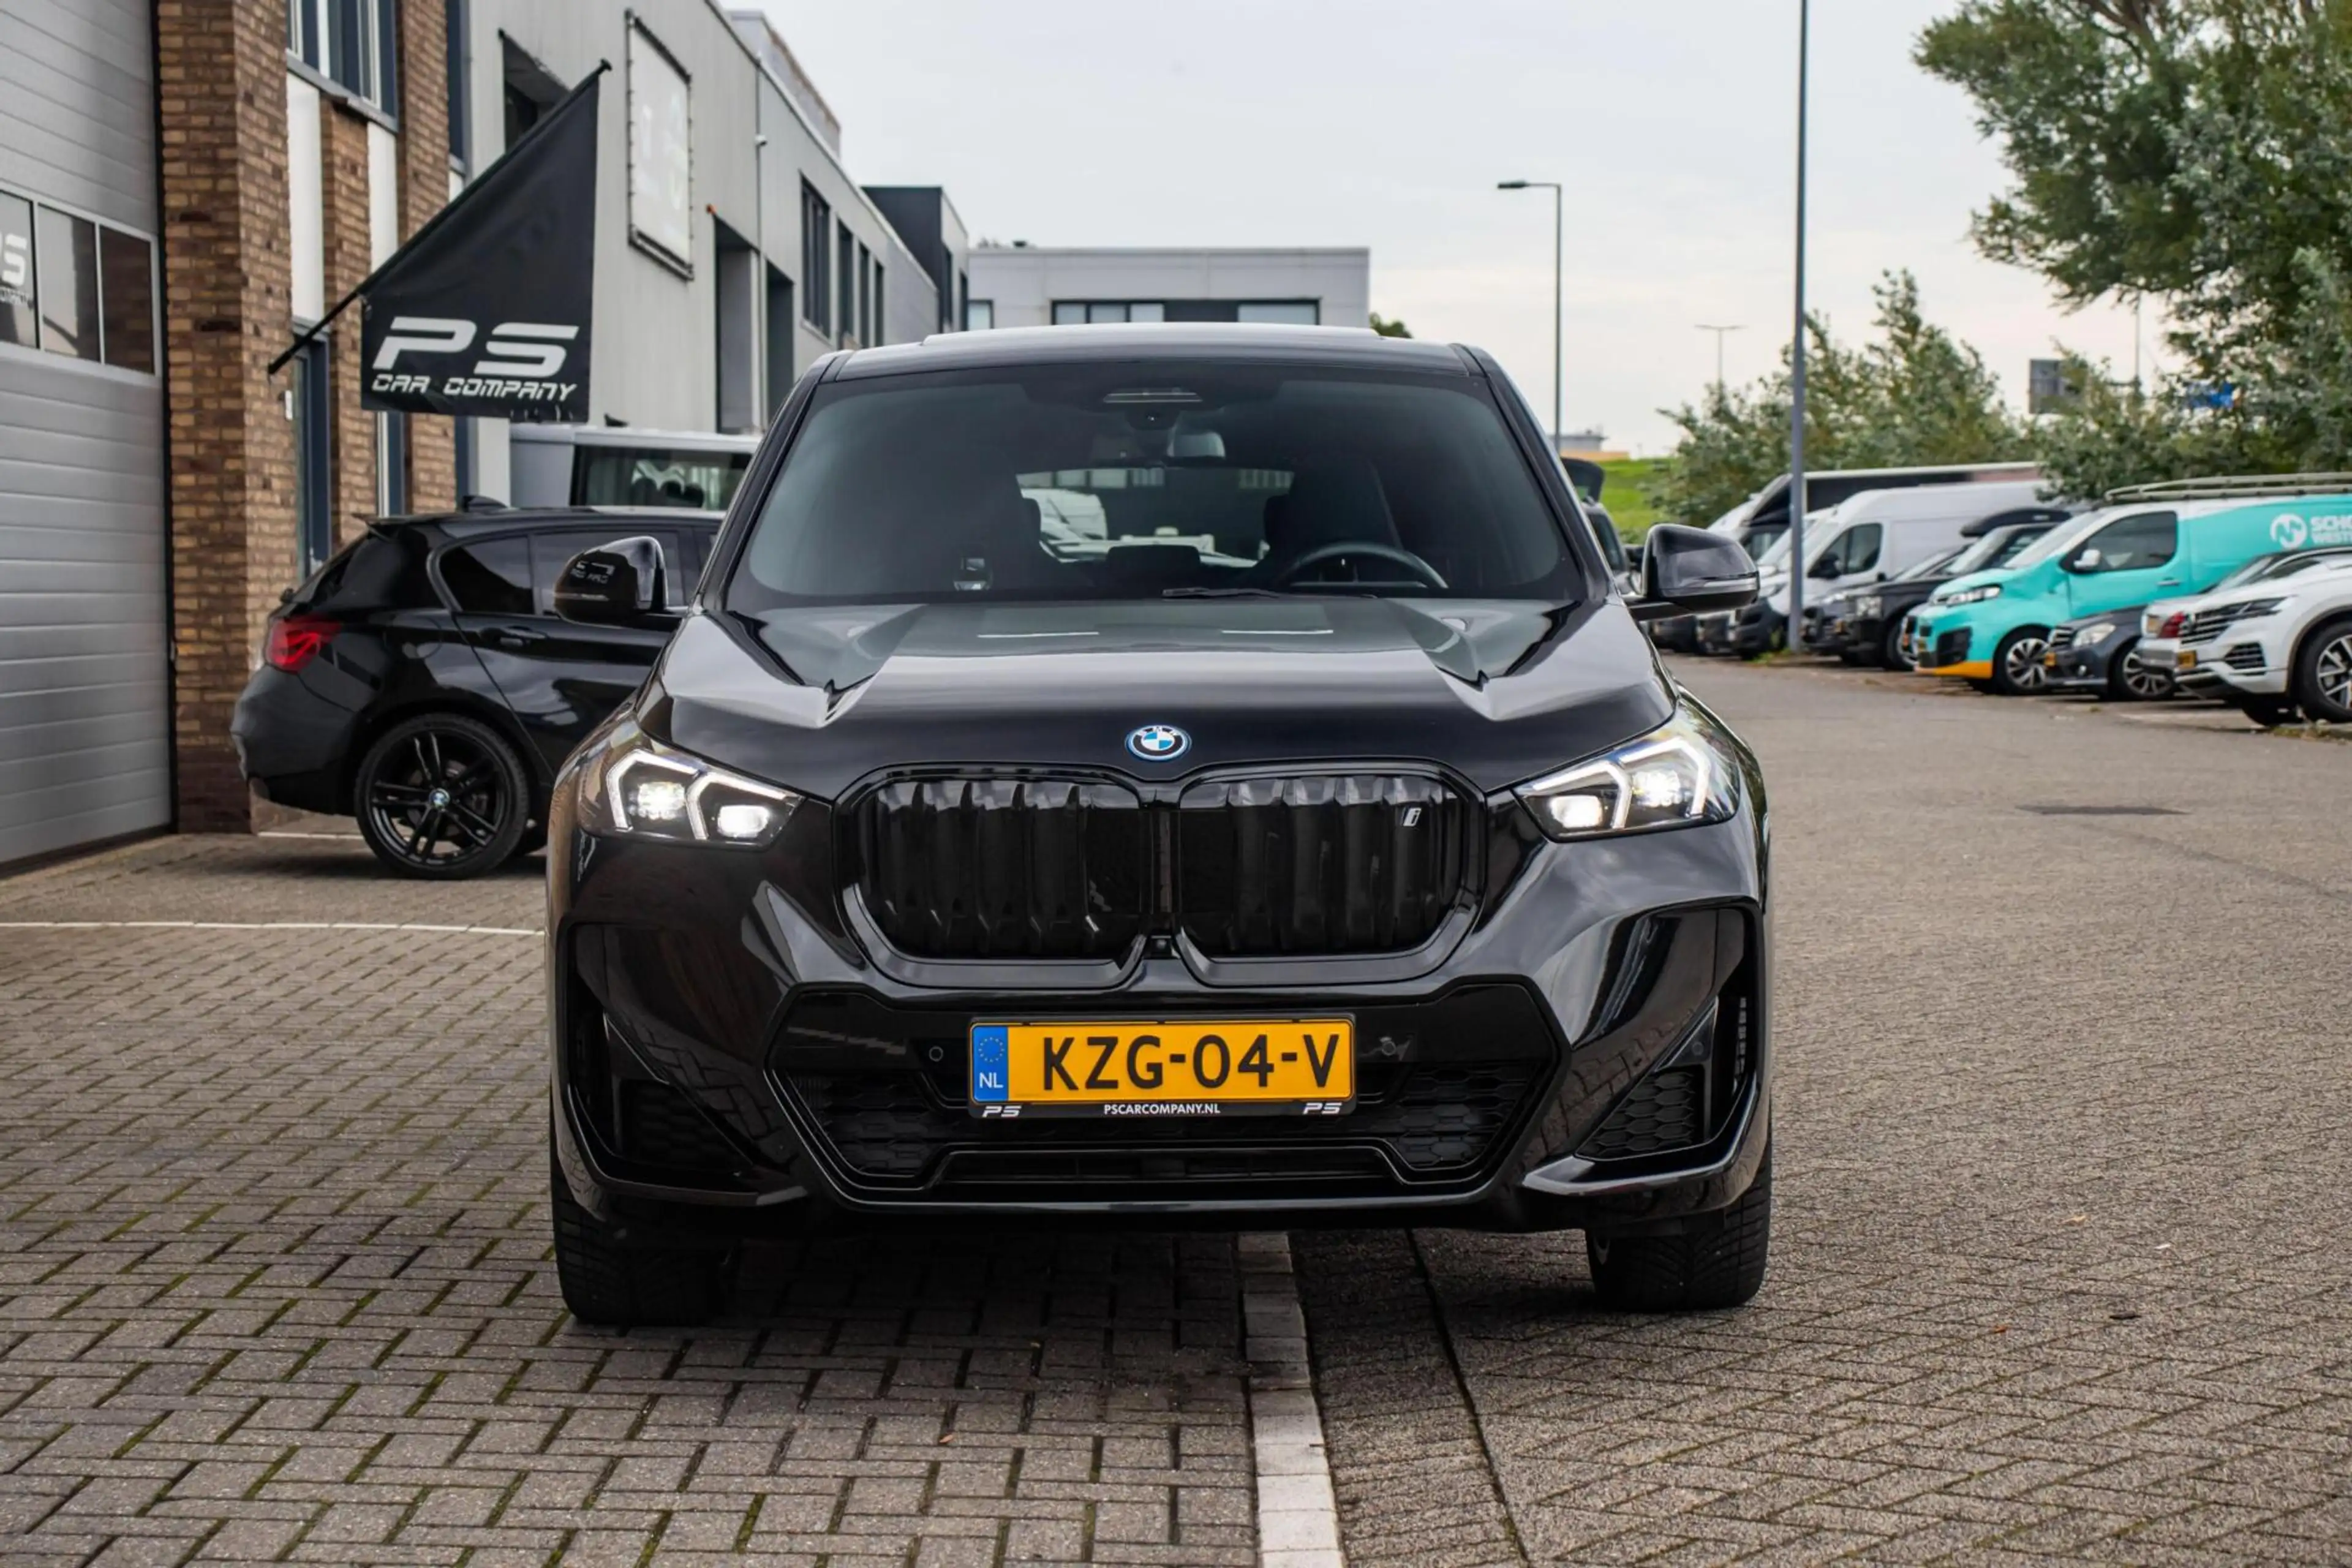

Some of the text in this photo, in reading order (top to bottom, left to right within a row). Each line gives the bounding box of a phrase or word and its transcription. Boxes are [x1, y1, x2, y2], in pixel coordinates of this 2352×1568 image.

[0, 230, 27, 286] S
[372, 316, 579, 378] PS
[371, 374, 578, 401] CAR COMPANY
[1043, 1034, 1340, 1091] KZG-04-V
[979, 1072, 1004, 1088] NL
[982, 1105, 1022, 1118] PS
[1104, 1103, 1221, 1115] PSCARCOMPANY.NL
[1303, 1102, 1343, 1115] PS
